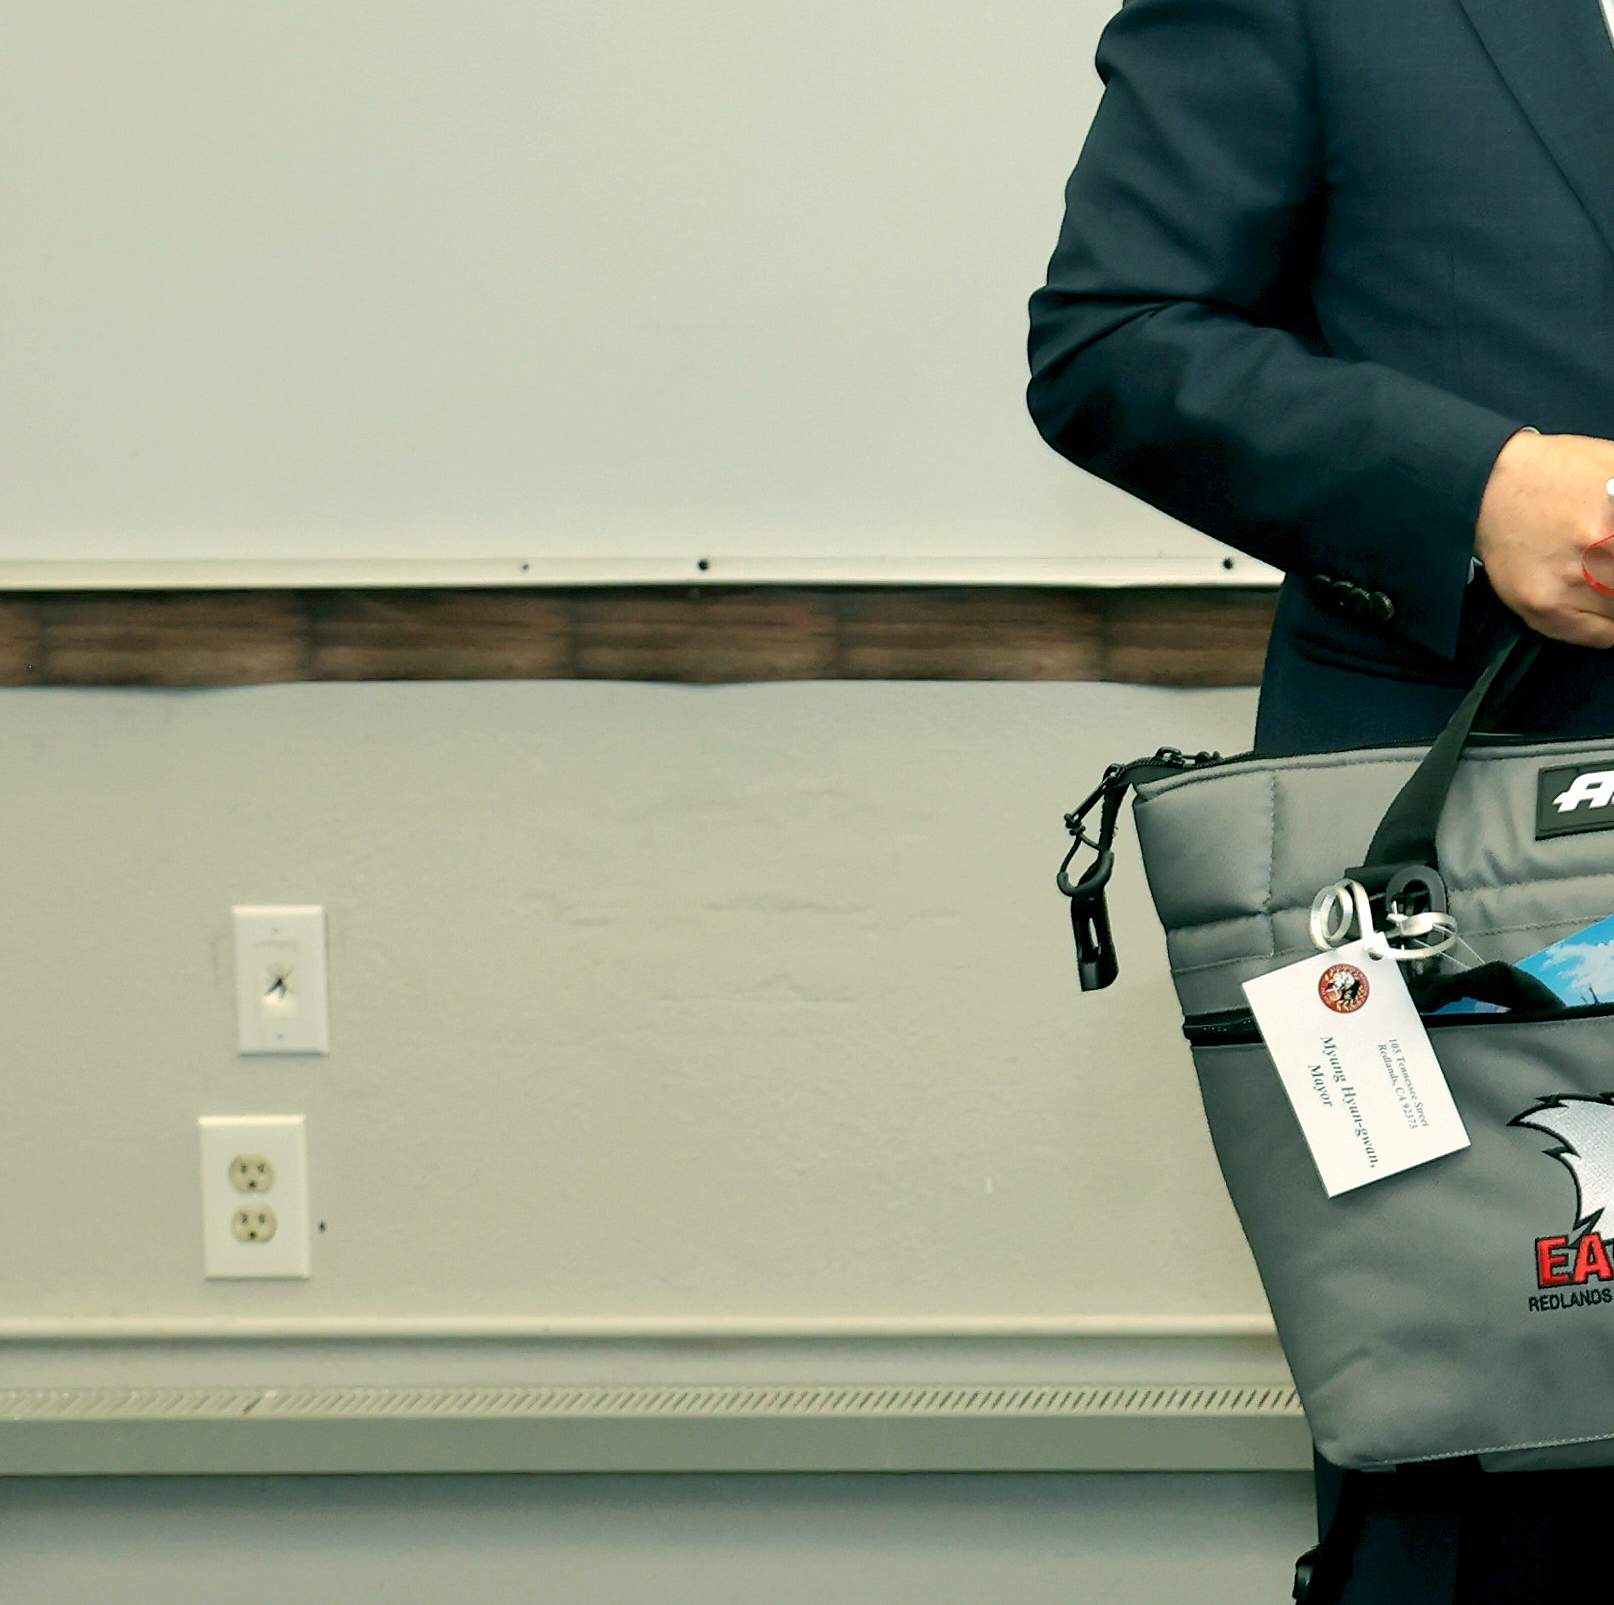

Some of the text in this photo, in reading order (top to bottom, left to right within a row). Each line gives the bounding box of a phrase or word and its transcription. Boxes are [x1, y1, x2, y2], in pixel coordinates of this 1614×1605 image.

[1307, 1064, 1333, 1107] Mayor
[1320, 1036, 1346, 1083] Myung
[1341, 1086, 1379, 1168] Hyun-gwan,
[1378, 1044, 1399, 1086] Redlands,
[1395, 1086, 1407, 1102] CA
[1389, 1038, 1430, 1127] 105 Tennessee Street
[1528, 1288, 1613, 1313] REDLANDS
